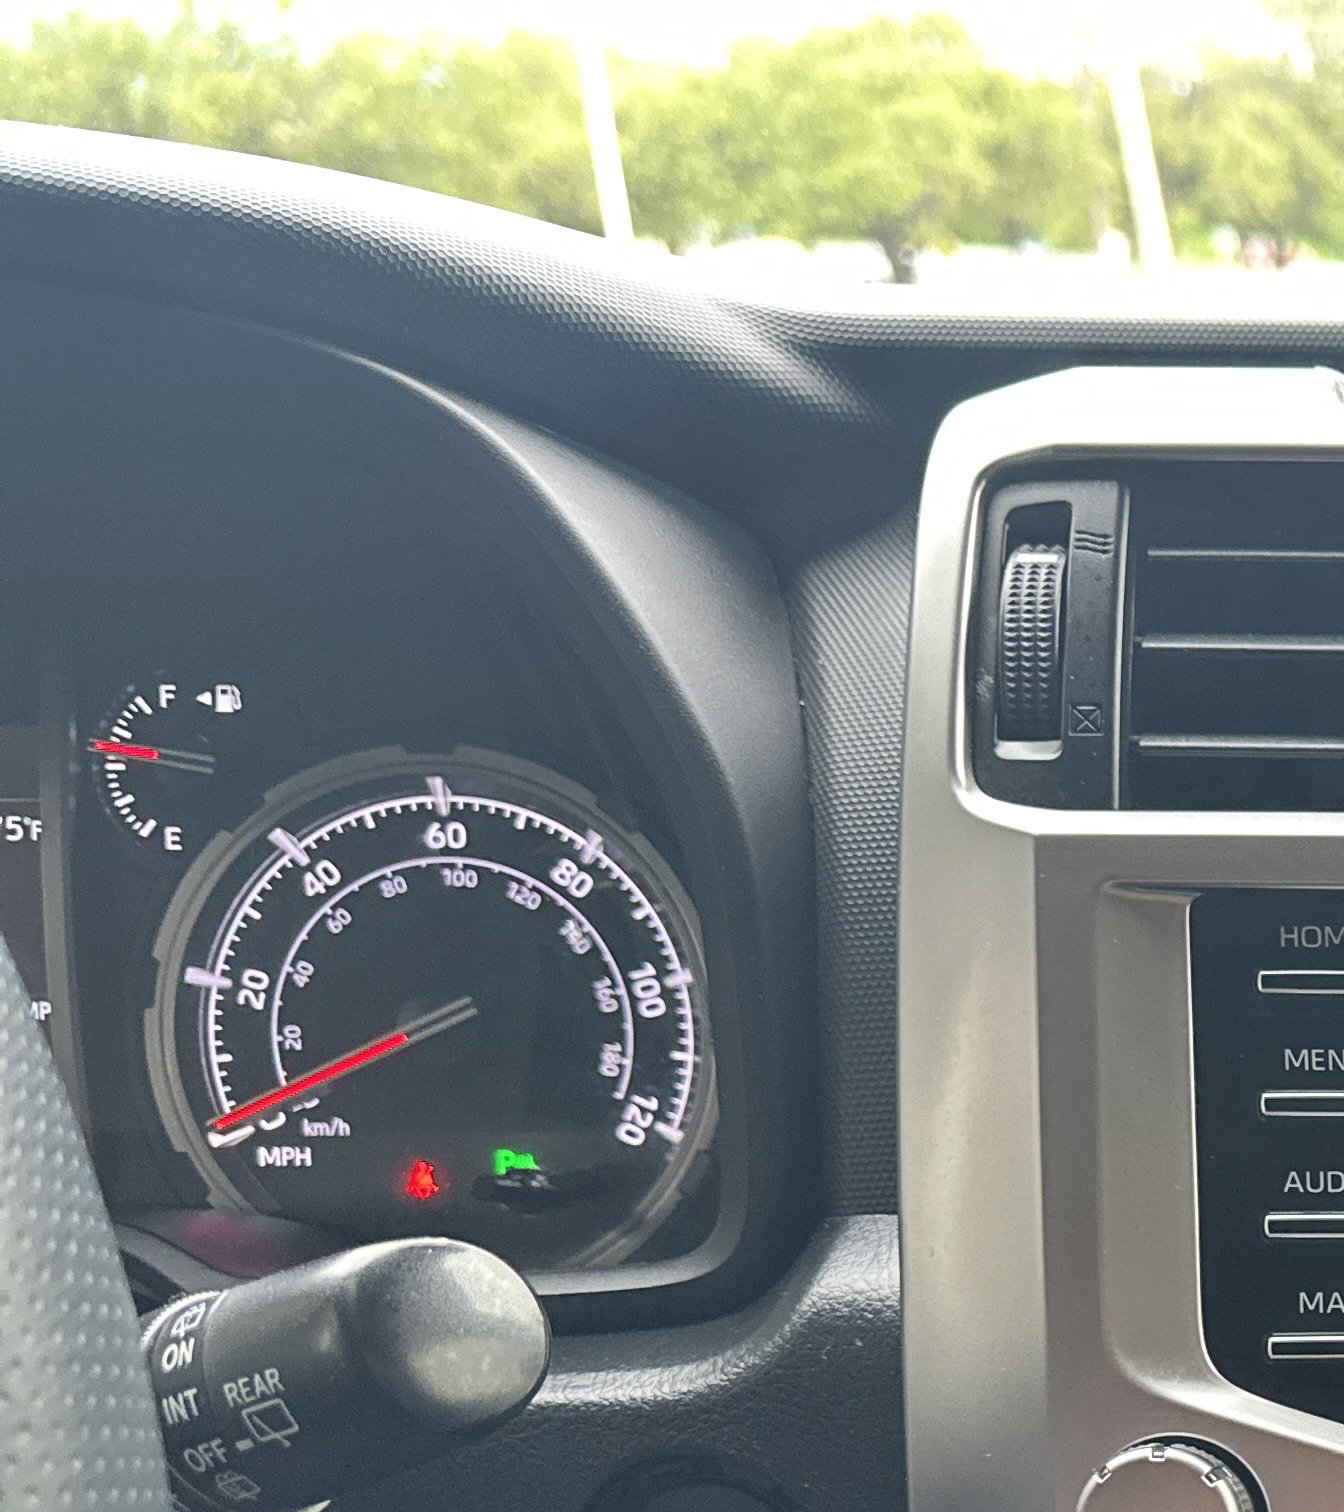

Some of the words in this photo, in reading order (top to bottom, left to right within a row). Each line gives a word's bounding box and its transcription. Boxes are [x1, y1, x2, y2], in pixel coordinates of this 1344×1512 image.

[158, 683, 177, 709] F
[0, 815, 43, 842] 5°F
[163, 825, 184, 851] E
[424, 821, 468, 850] 60
[302, 858, 343, 898] 40
[379, 875, 409, 900] 80
[440, 867, 479, 890] 100
[549, 857, 594, 899] 80
[504, 881, 543, 912] 120
[325, 907, 352, 935] 60
[291, 960, 316, 988] 40
[237, 967, 271, 1011] 20
[627, 961, 667, 1019] 100
[281, 1023, 304, 1051] 20
[302, 1116, 352, 1138] km/h
[614, 1093, 660, 1148] 120
[256, 1146, 313, 1168] MPH
[160, 1337, 196, 1374] ON
[222, 1367, 286, 1408] REAR
[161, 1387, 200, 1426] INT
[182, 1437, 229, 1473] OFF
